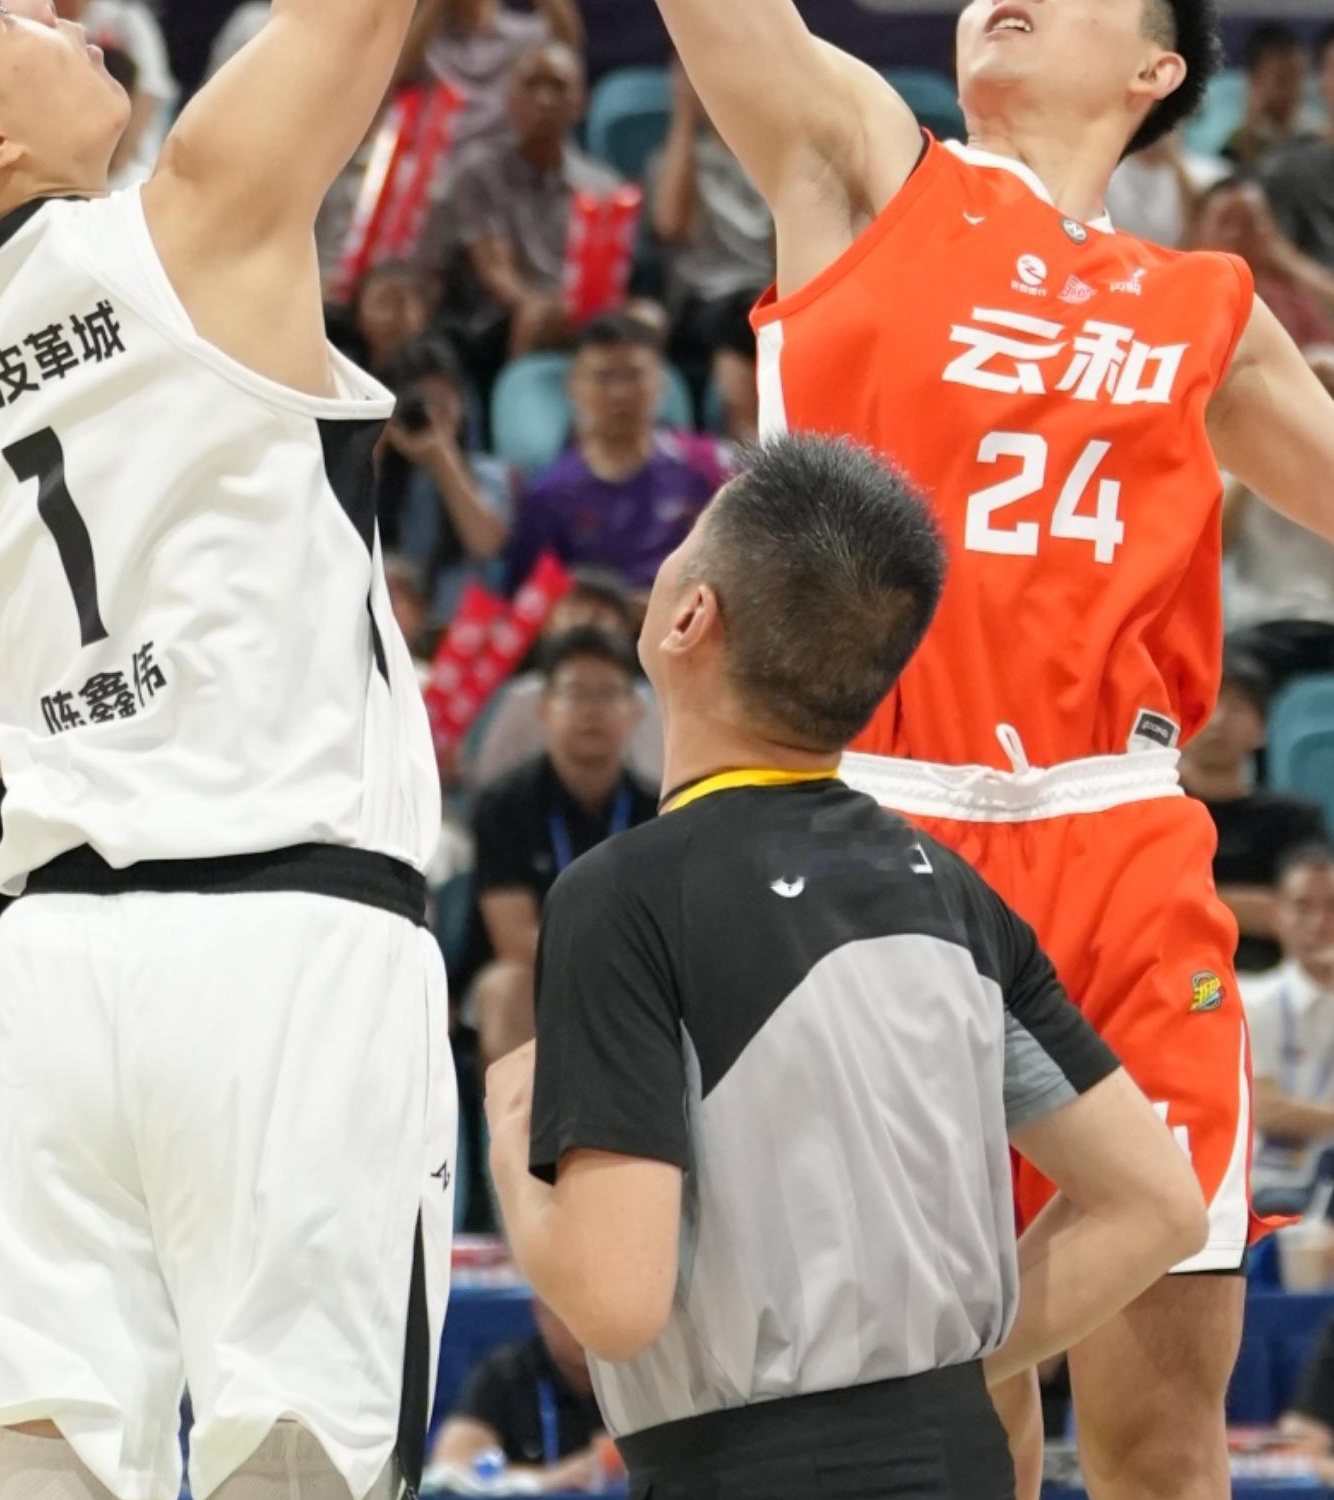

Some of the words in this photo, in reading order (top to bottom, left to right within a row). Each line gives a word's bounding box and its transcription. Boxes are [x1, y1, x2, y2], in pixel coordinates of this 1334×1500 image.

[942, 306, 1190, 405] 云和
[964, 430, 1125, 565] 24
[40, 641, 168, 736] 陈鑫伟
